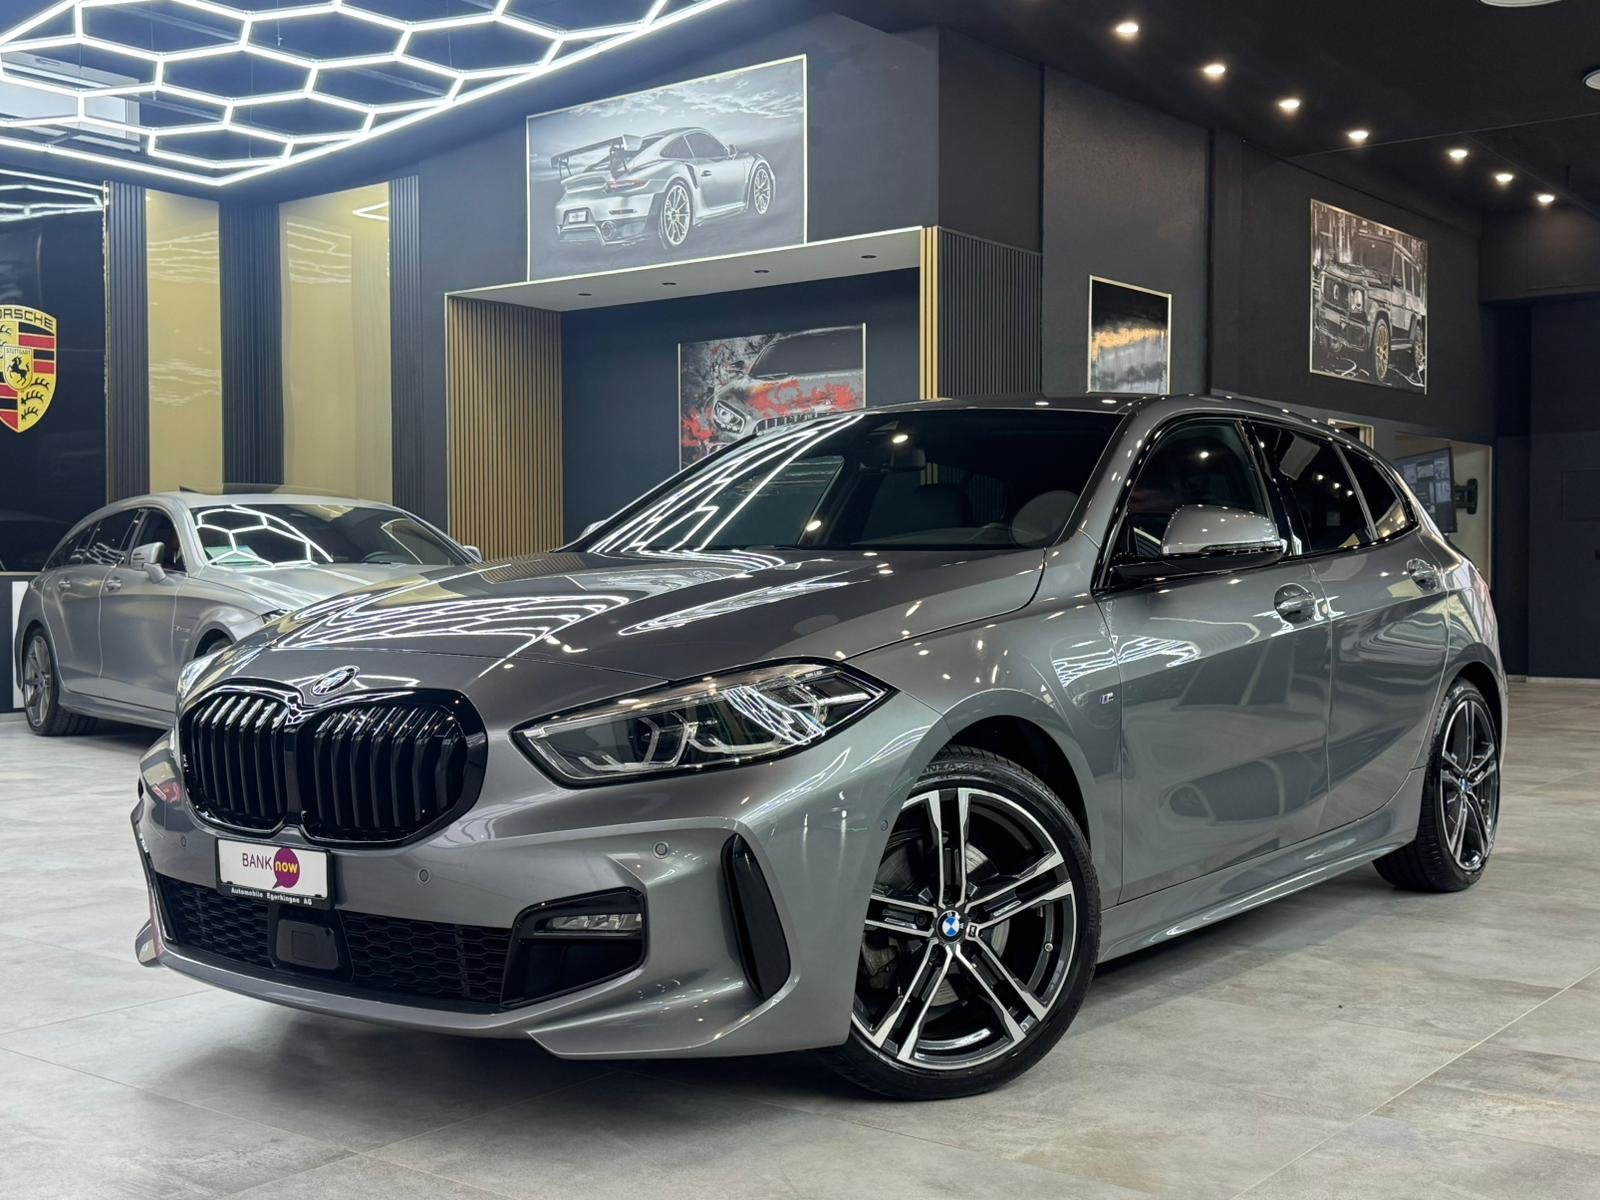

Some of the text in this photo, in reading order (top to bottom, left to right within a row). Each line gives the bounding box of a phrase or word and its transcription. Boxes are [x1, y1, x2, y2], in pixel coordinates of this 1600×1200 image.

[0, 308, 53, 331] RSCHE
[242, 852, 298, 874] BANK now
[231, 887, 263, 898] Automobile
[303, 897, 312, 906] AG
